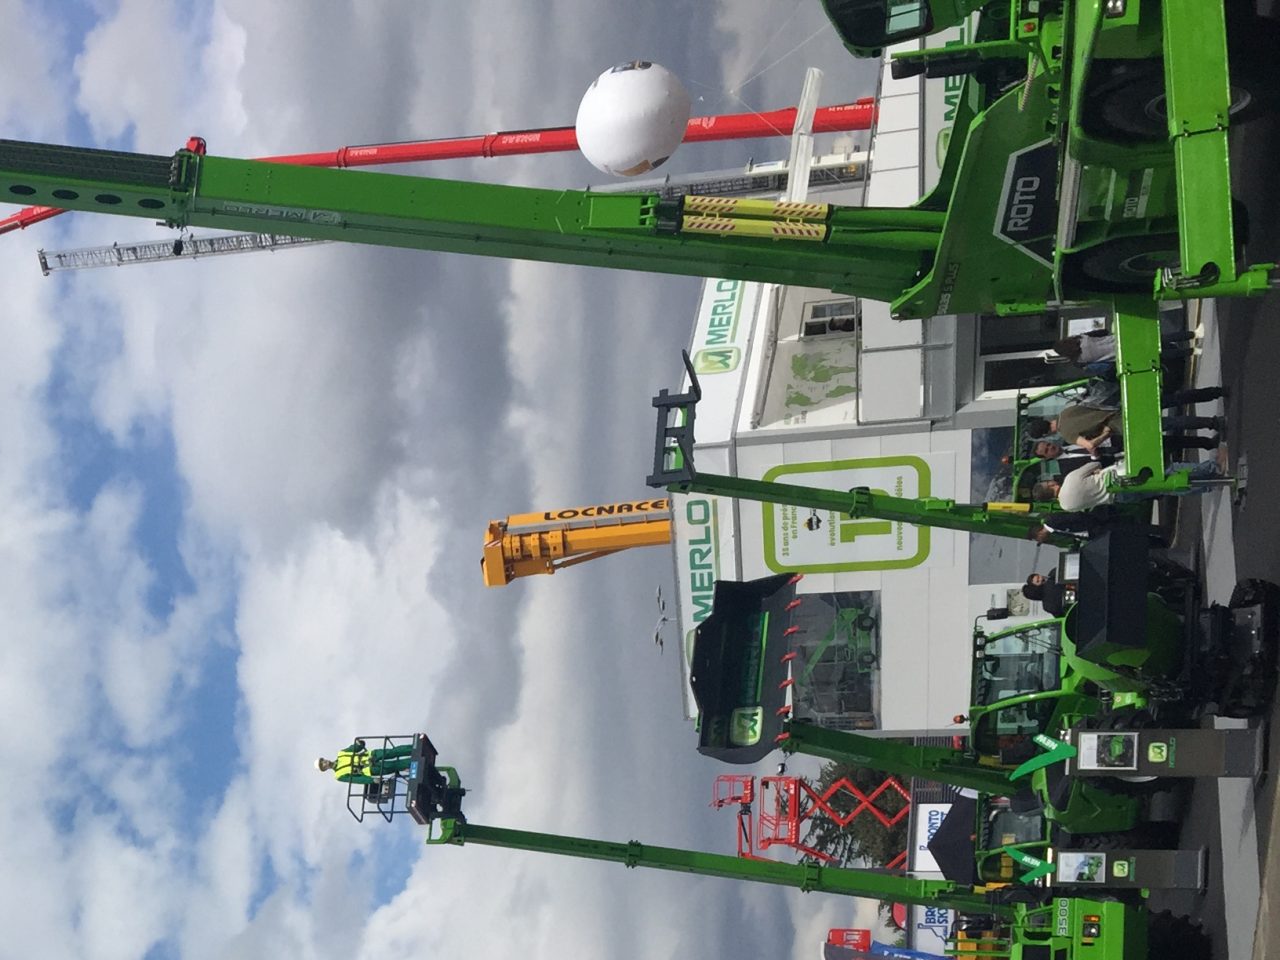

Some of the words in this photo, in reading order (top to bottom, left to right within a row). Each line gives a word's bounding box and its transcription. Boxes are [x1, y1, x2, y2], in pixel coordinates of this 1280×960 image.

[1005, 176, 1041, 232] ROTO
[704, 279, 739, 345] MERLO
[544, 500, 669, 520] LOCNACE
[790, 506, 798, 528] Franc
[781, 521, 789, 531] de
[686, 500, 714, 622] MERLO
[1036, 733, 1058, 751] NEW
[927, 809, 940, 839] RONTO
[1057, 897, 1069, 935] 3500
